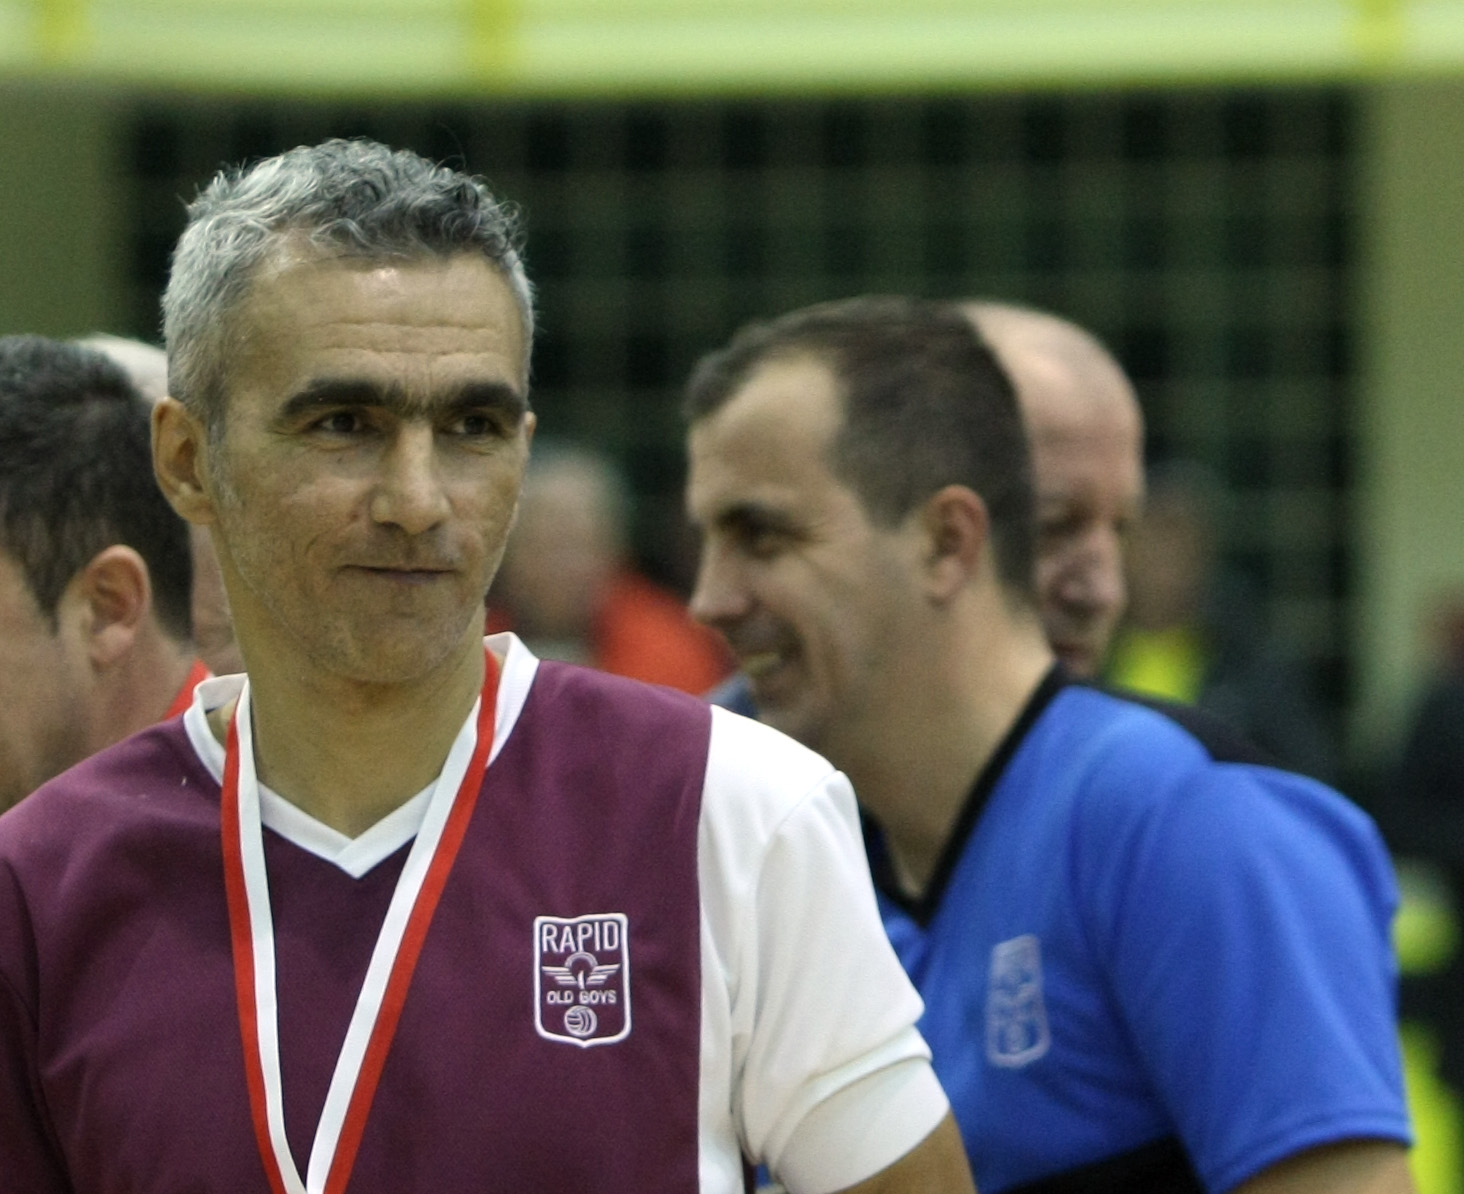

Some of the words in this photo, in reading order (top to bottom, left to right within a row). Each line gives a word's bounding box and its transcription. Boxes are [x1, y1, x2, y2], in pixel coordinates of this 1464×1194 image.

[542, 921, 619, 953] RAPID
[547, 990, 574, 1004] OLD
[579, 989, 617, 1004] BOYS
